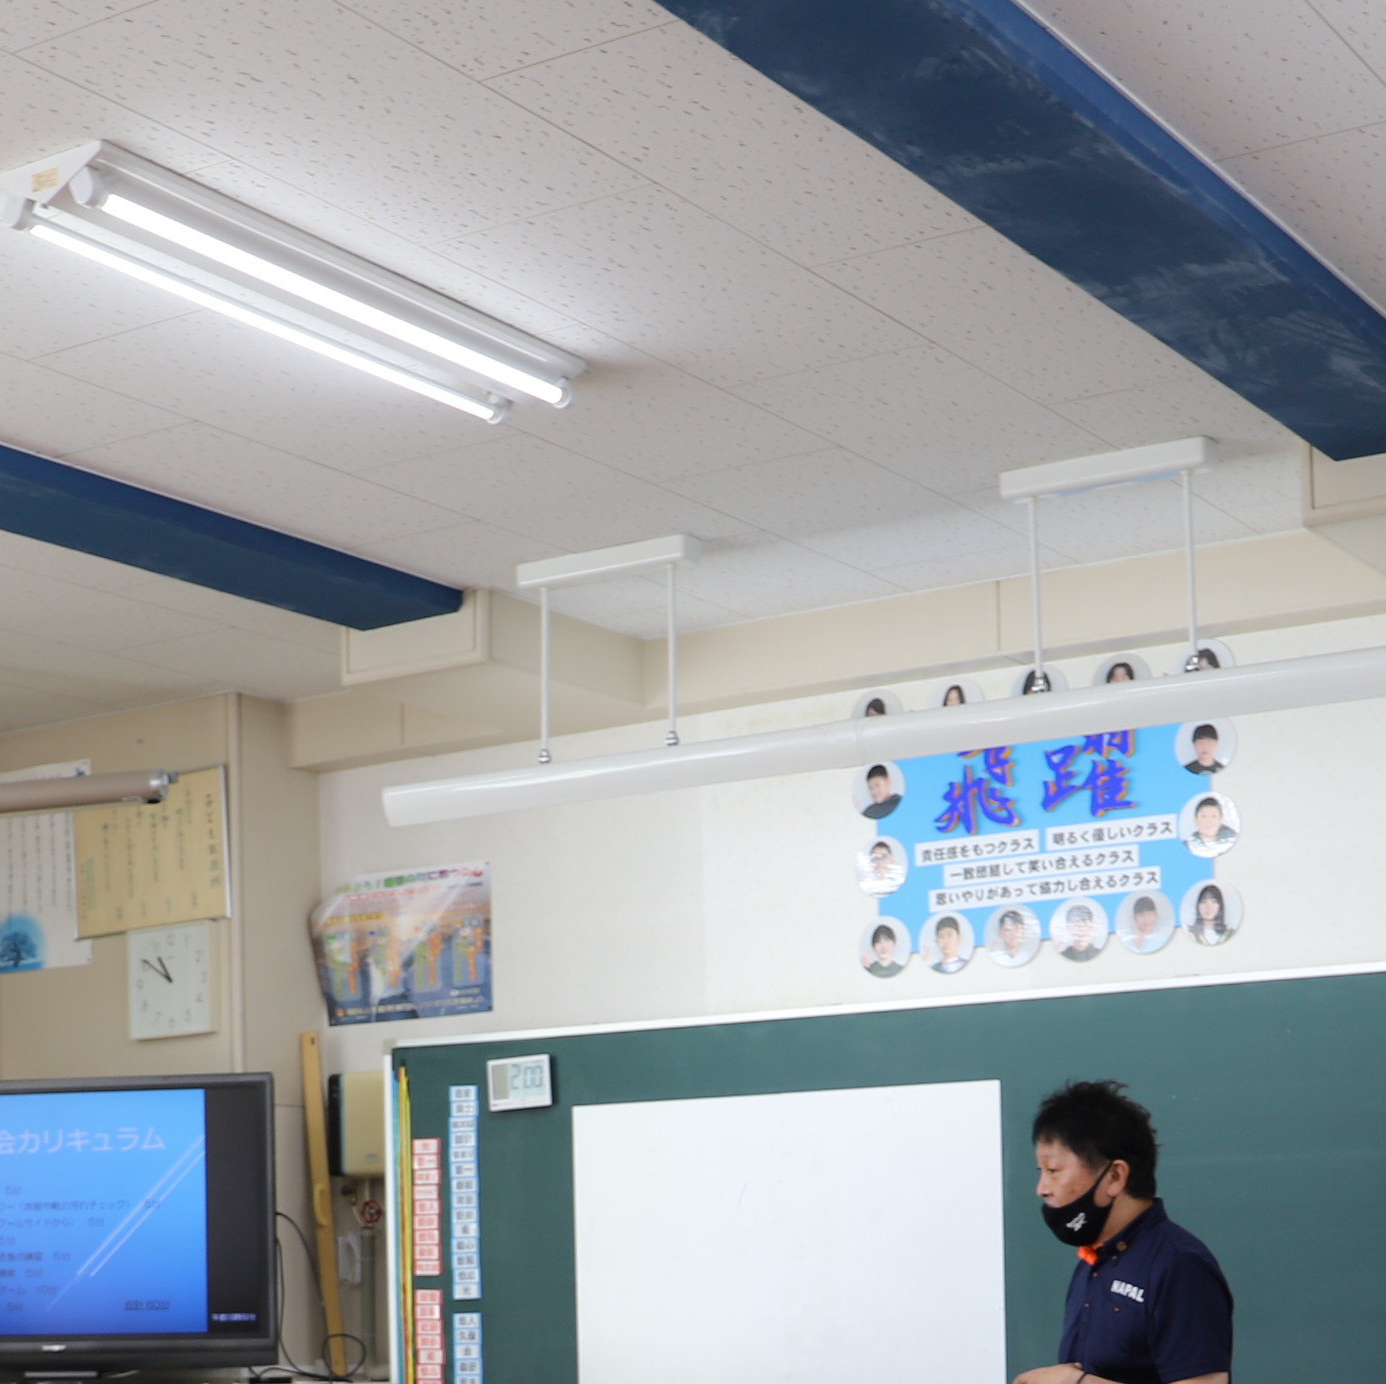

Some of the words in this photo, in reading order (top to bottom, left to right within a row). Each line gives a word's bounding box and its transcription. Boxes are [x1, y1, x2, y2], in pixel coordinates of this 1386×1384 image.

[920, 837, 1036, 863] 責任感をもつクラス
[1051, 820, 1174, 846] 明るく優しいクラス
[949, 849, 1136, 881] 一致団結して笑い合えるクラス
[934, 870, 1160, 906] 思いやりがあって協力し合えるクラス
